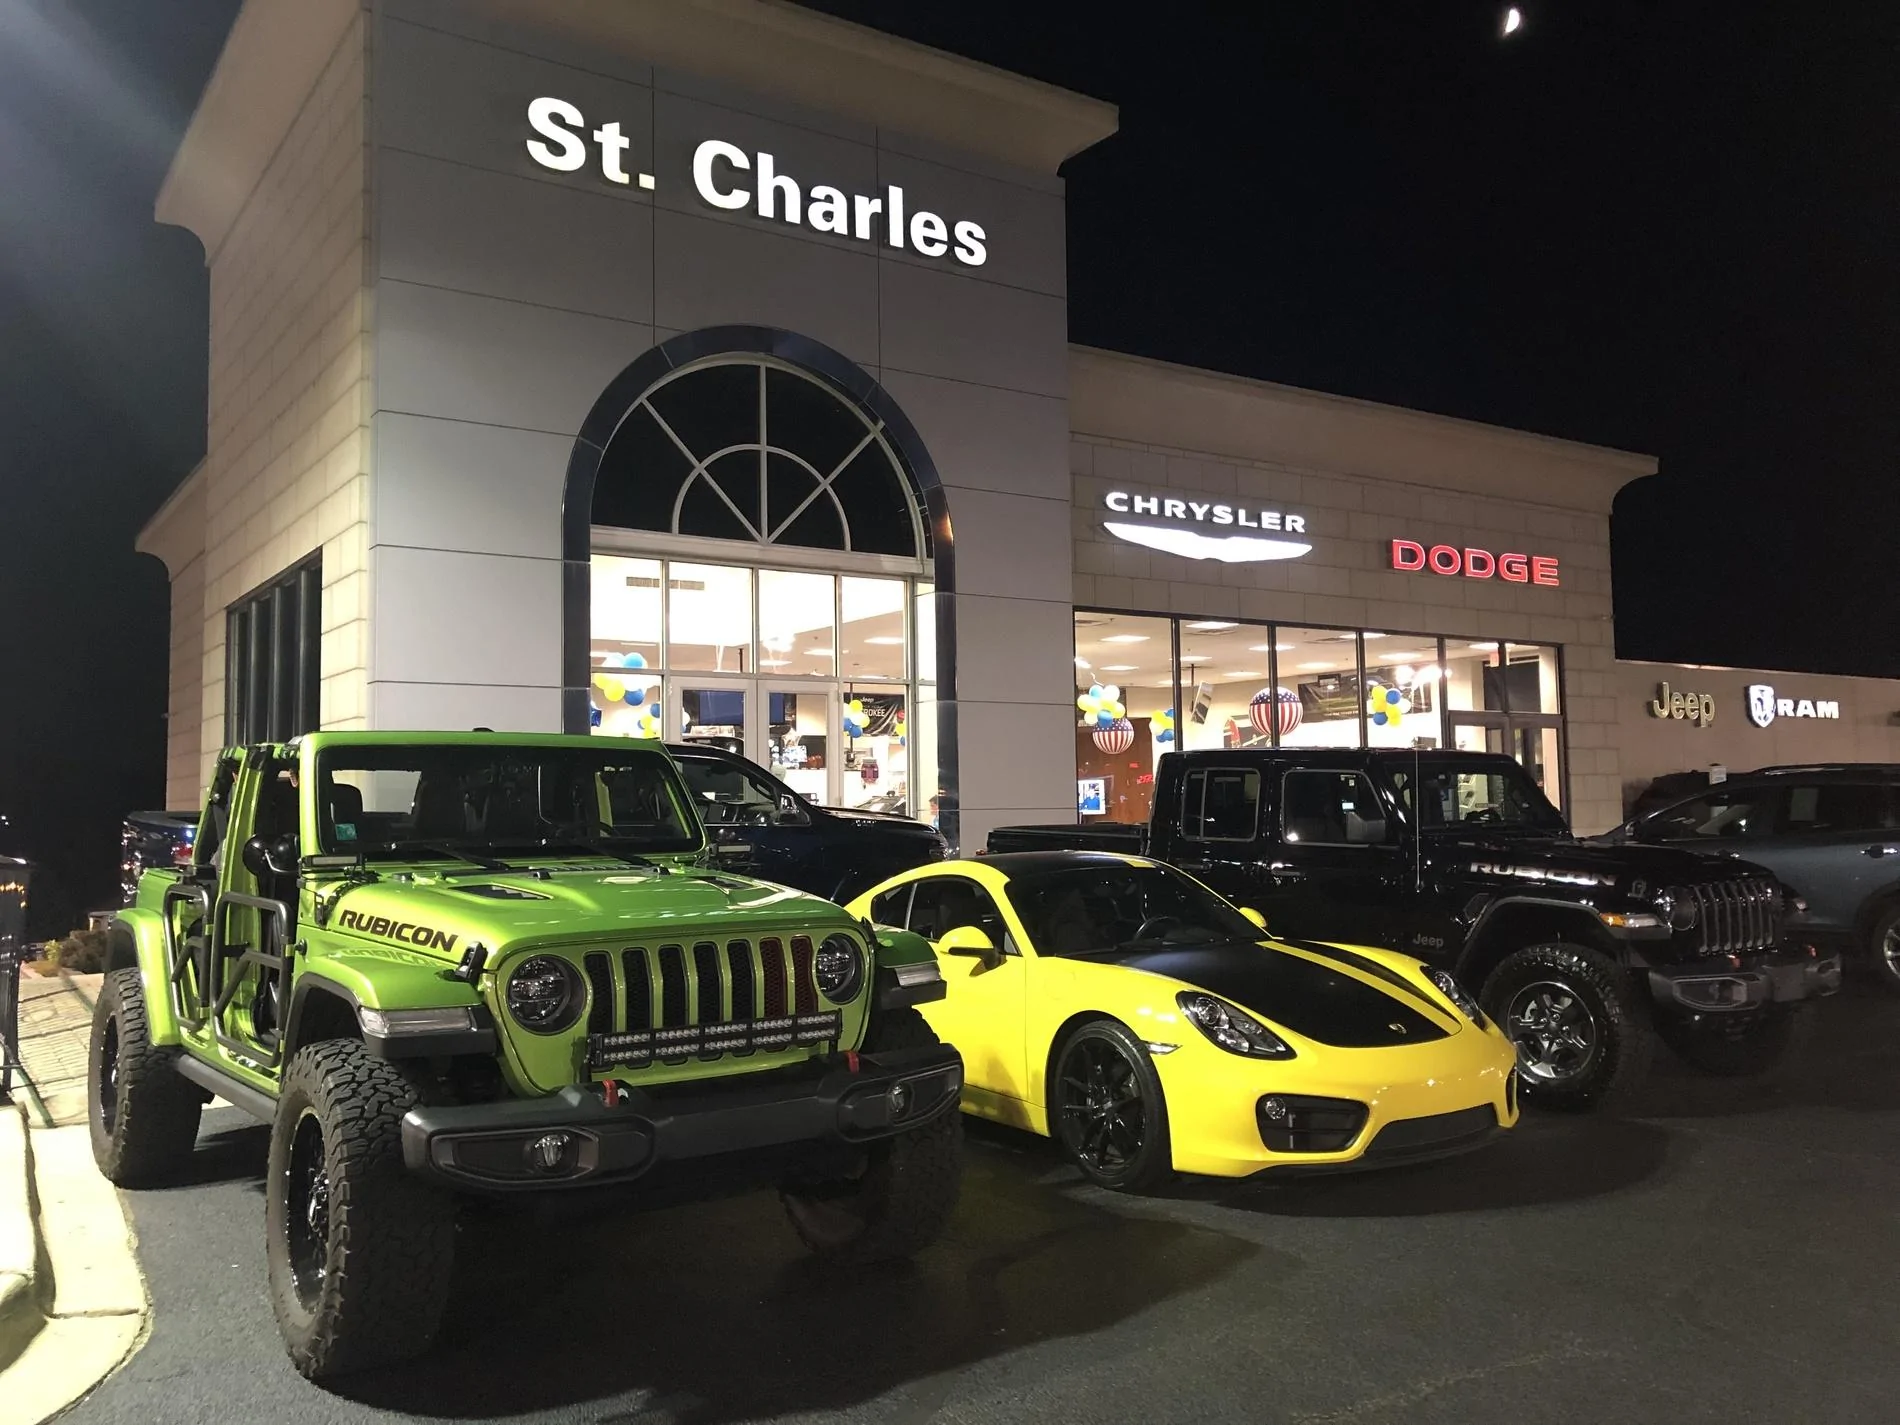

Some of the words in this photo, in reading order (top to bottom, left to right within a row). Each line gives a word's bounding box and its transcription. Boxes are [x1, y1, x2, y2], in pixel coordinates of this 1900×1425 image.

[526, 97, 655, 189] St.
[693, 140, 987, 266] Charles
[1105, 491, 1306, 532] CHRYSLER
[1392, 539, 1560, 586] DODGE
[1653, 681, 1715, 728] Jeep
[1776, 698, 1840, 719] RAM
[338, 909, 458, 952] RUBICON
[1412, 932, 1444, 949] Jeep
